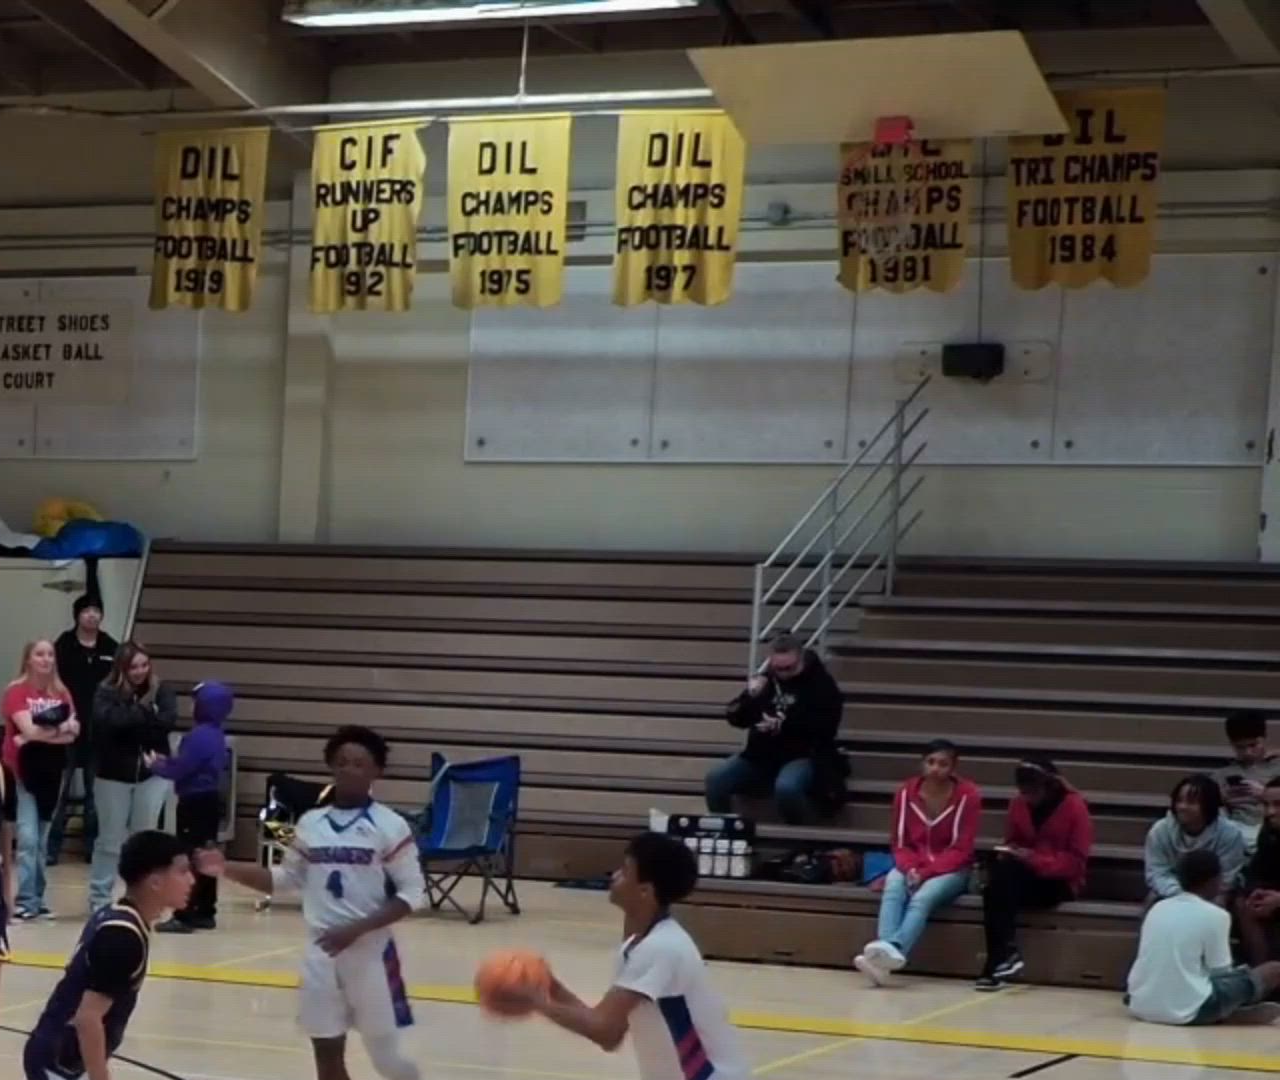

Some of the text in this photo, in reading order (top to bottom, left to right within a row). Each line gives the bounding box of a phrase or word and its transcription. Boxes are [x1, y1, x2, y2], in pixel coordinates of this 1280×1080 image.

[181, 146, 240, 180] DIL
[340, 134, 400, 170] CIF
[478, 141, 538, 175] DIL
[647, 132, 712, 168] DIL
[904, 160, 969, 182] SCHOOL
[1011, 152, 1158, 186] TRI CHAMPS
[316, 179, 416, 208] RUNNERS
[461, 190, 554, 217] CHAMPS
[627, 183, 726, 210] CHAMPS
[161, 197, 251, 224] CHAMPS
[351, 208, 380, 233] UP
[1017, 195, 1145, 228] FOOTBALL
[154, 235, 254, 263] FOOTBALL
[452, 231, 559, 258] FOOTBALL
[617, 225, 731, 253] FOOTBALL
[1049, 234, 1117, 264] 1984
[311, 242, 414, 271] FOOTBALL
[57, 314, 109, 332] SHOES
[62, 342, 103, 361] BALL
[3, 372, 55, 389] COURT
